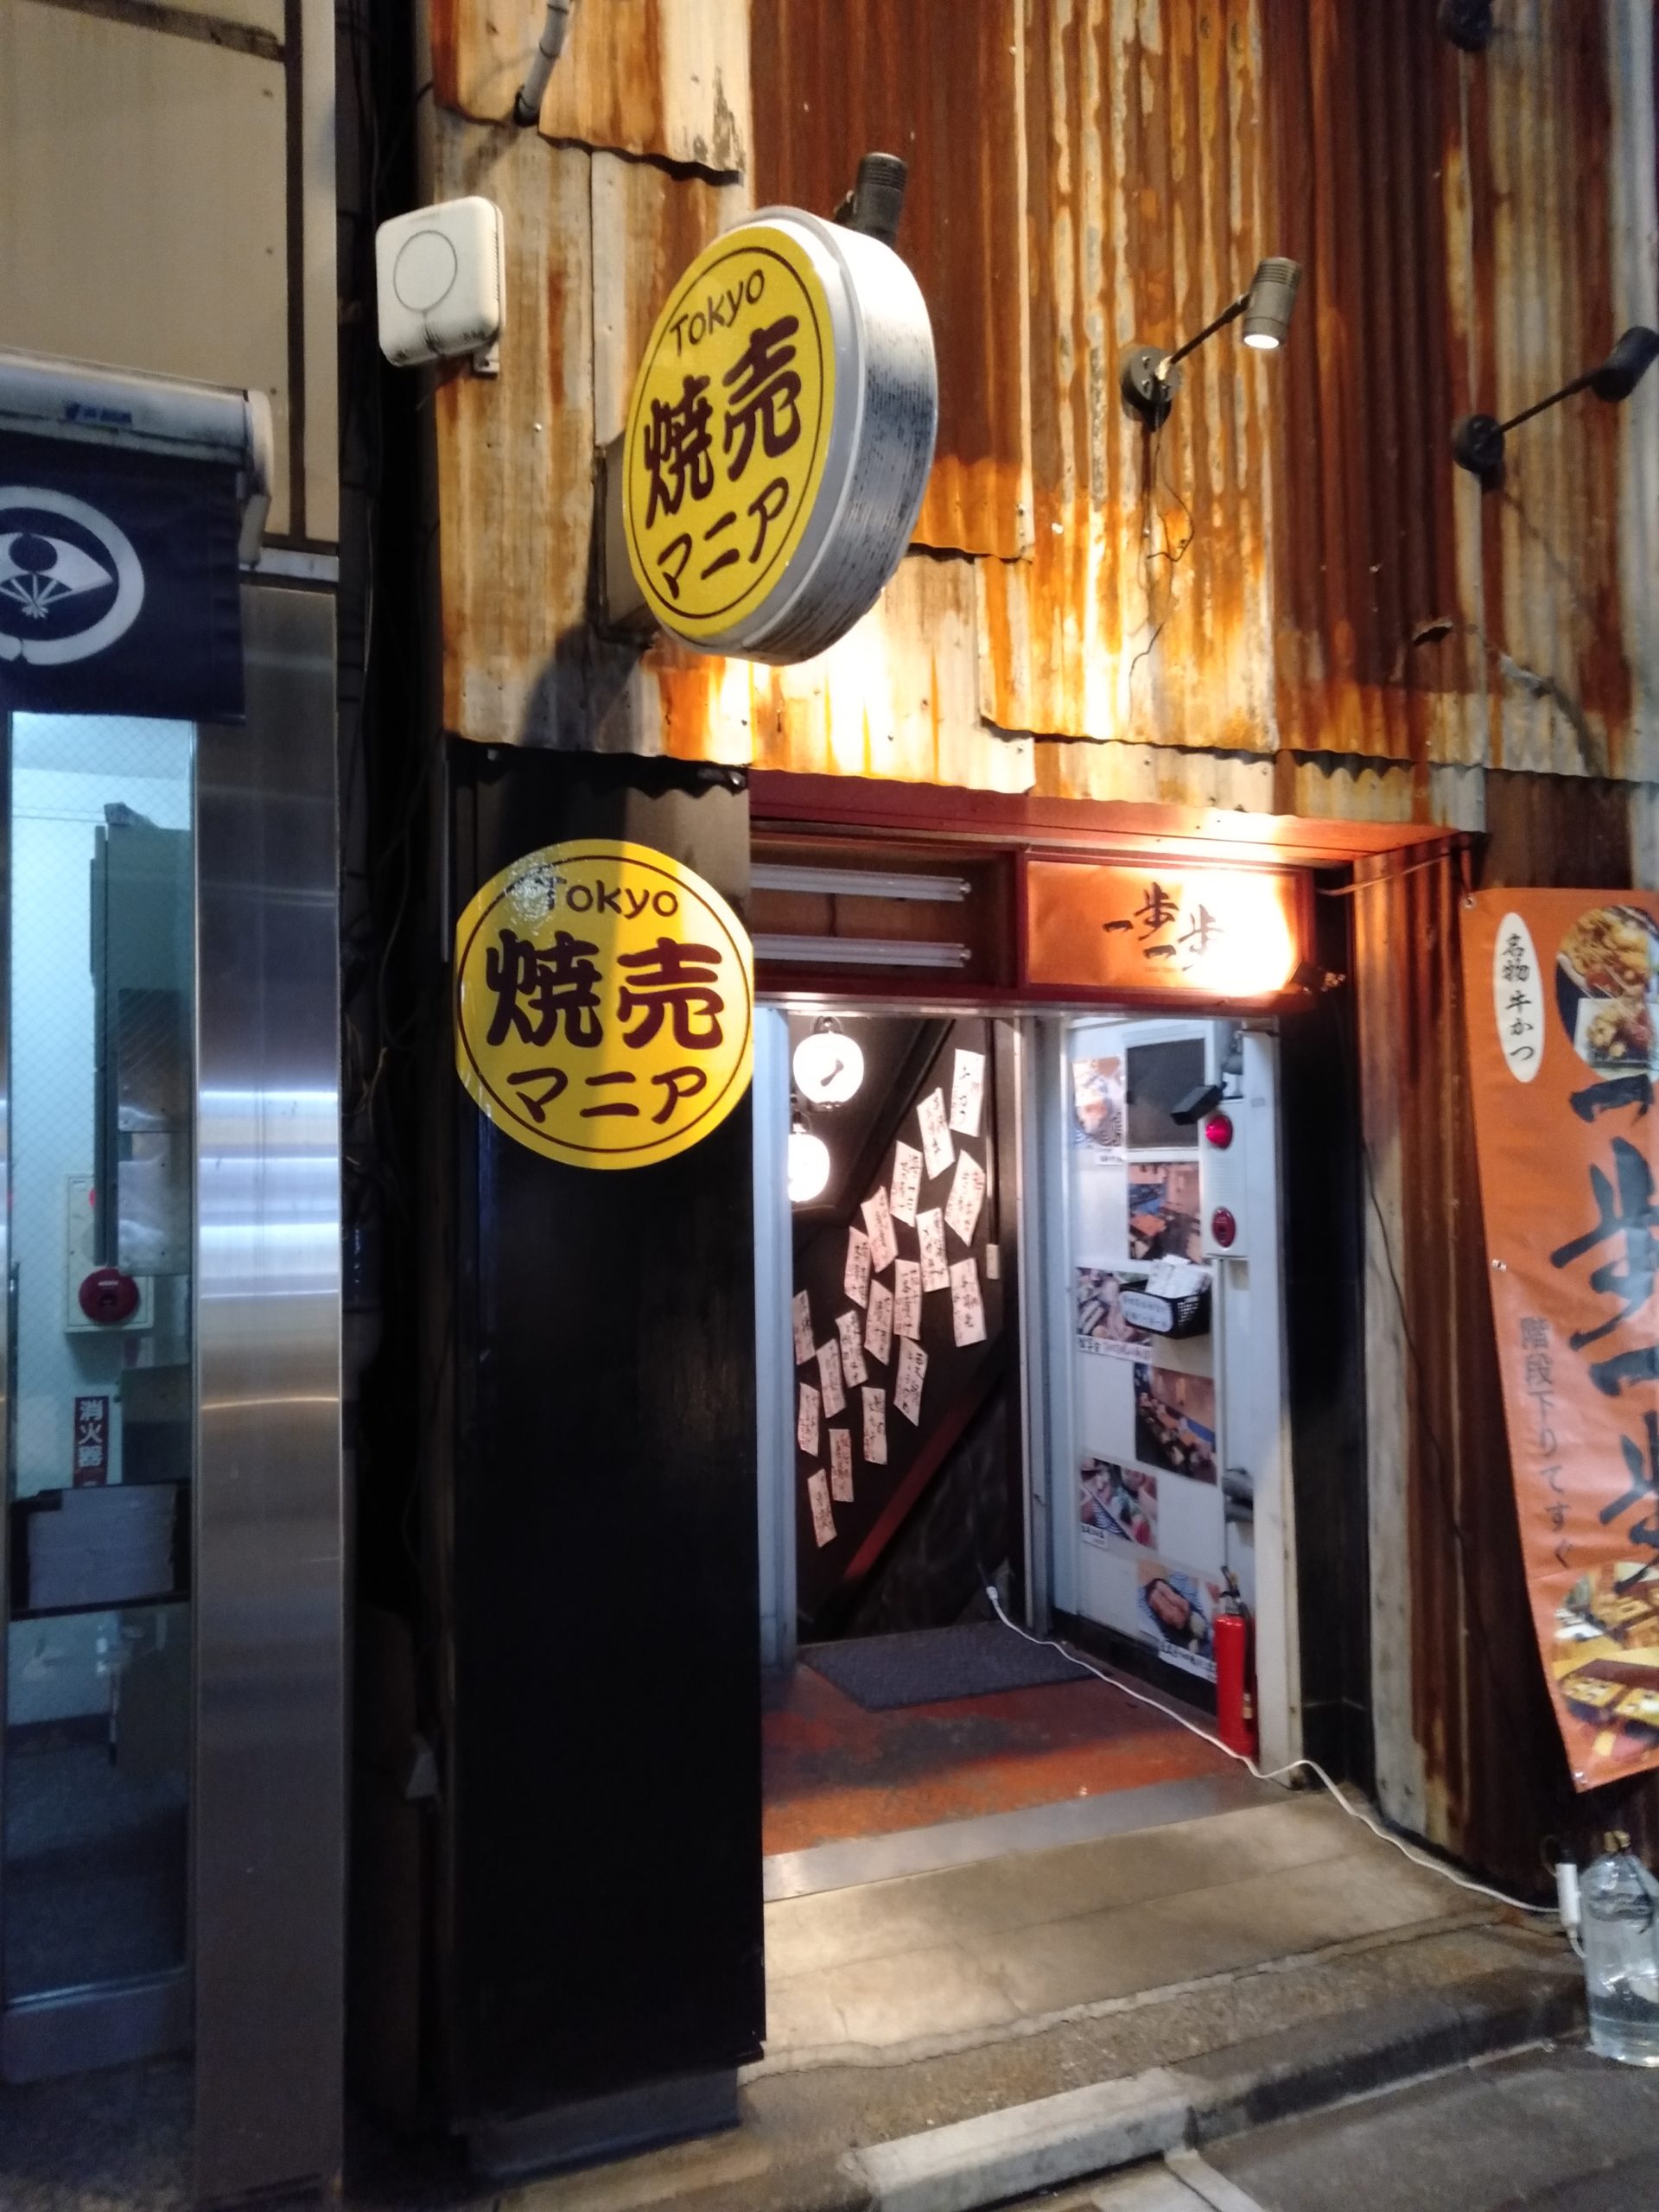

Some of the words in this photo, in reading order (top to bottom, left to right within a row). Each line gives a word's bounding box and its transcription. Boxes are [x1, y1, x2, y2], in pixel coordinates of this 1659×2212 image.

[645, 315, 802, 530] 焼売
[657, 476, 790, 601] マニア
[486, 928, 724, 1050] 焼売
[506, 1065, 708, 1124] マニア
[78, 1399, 104, 1468] 消火器
